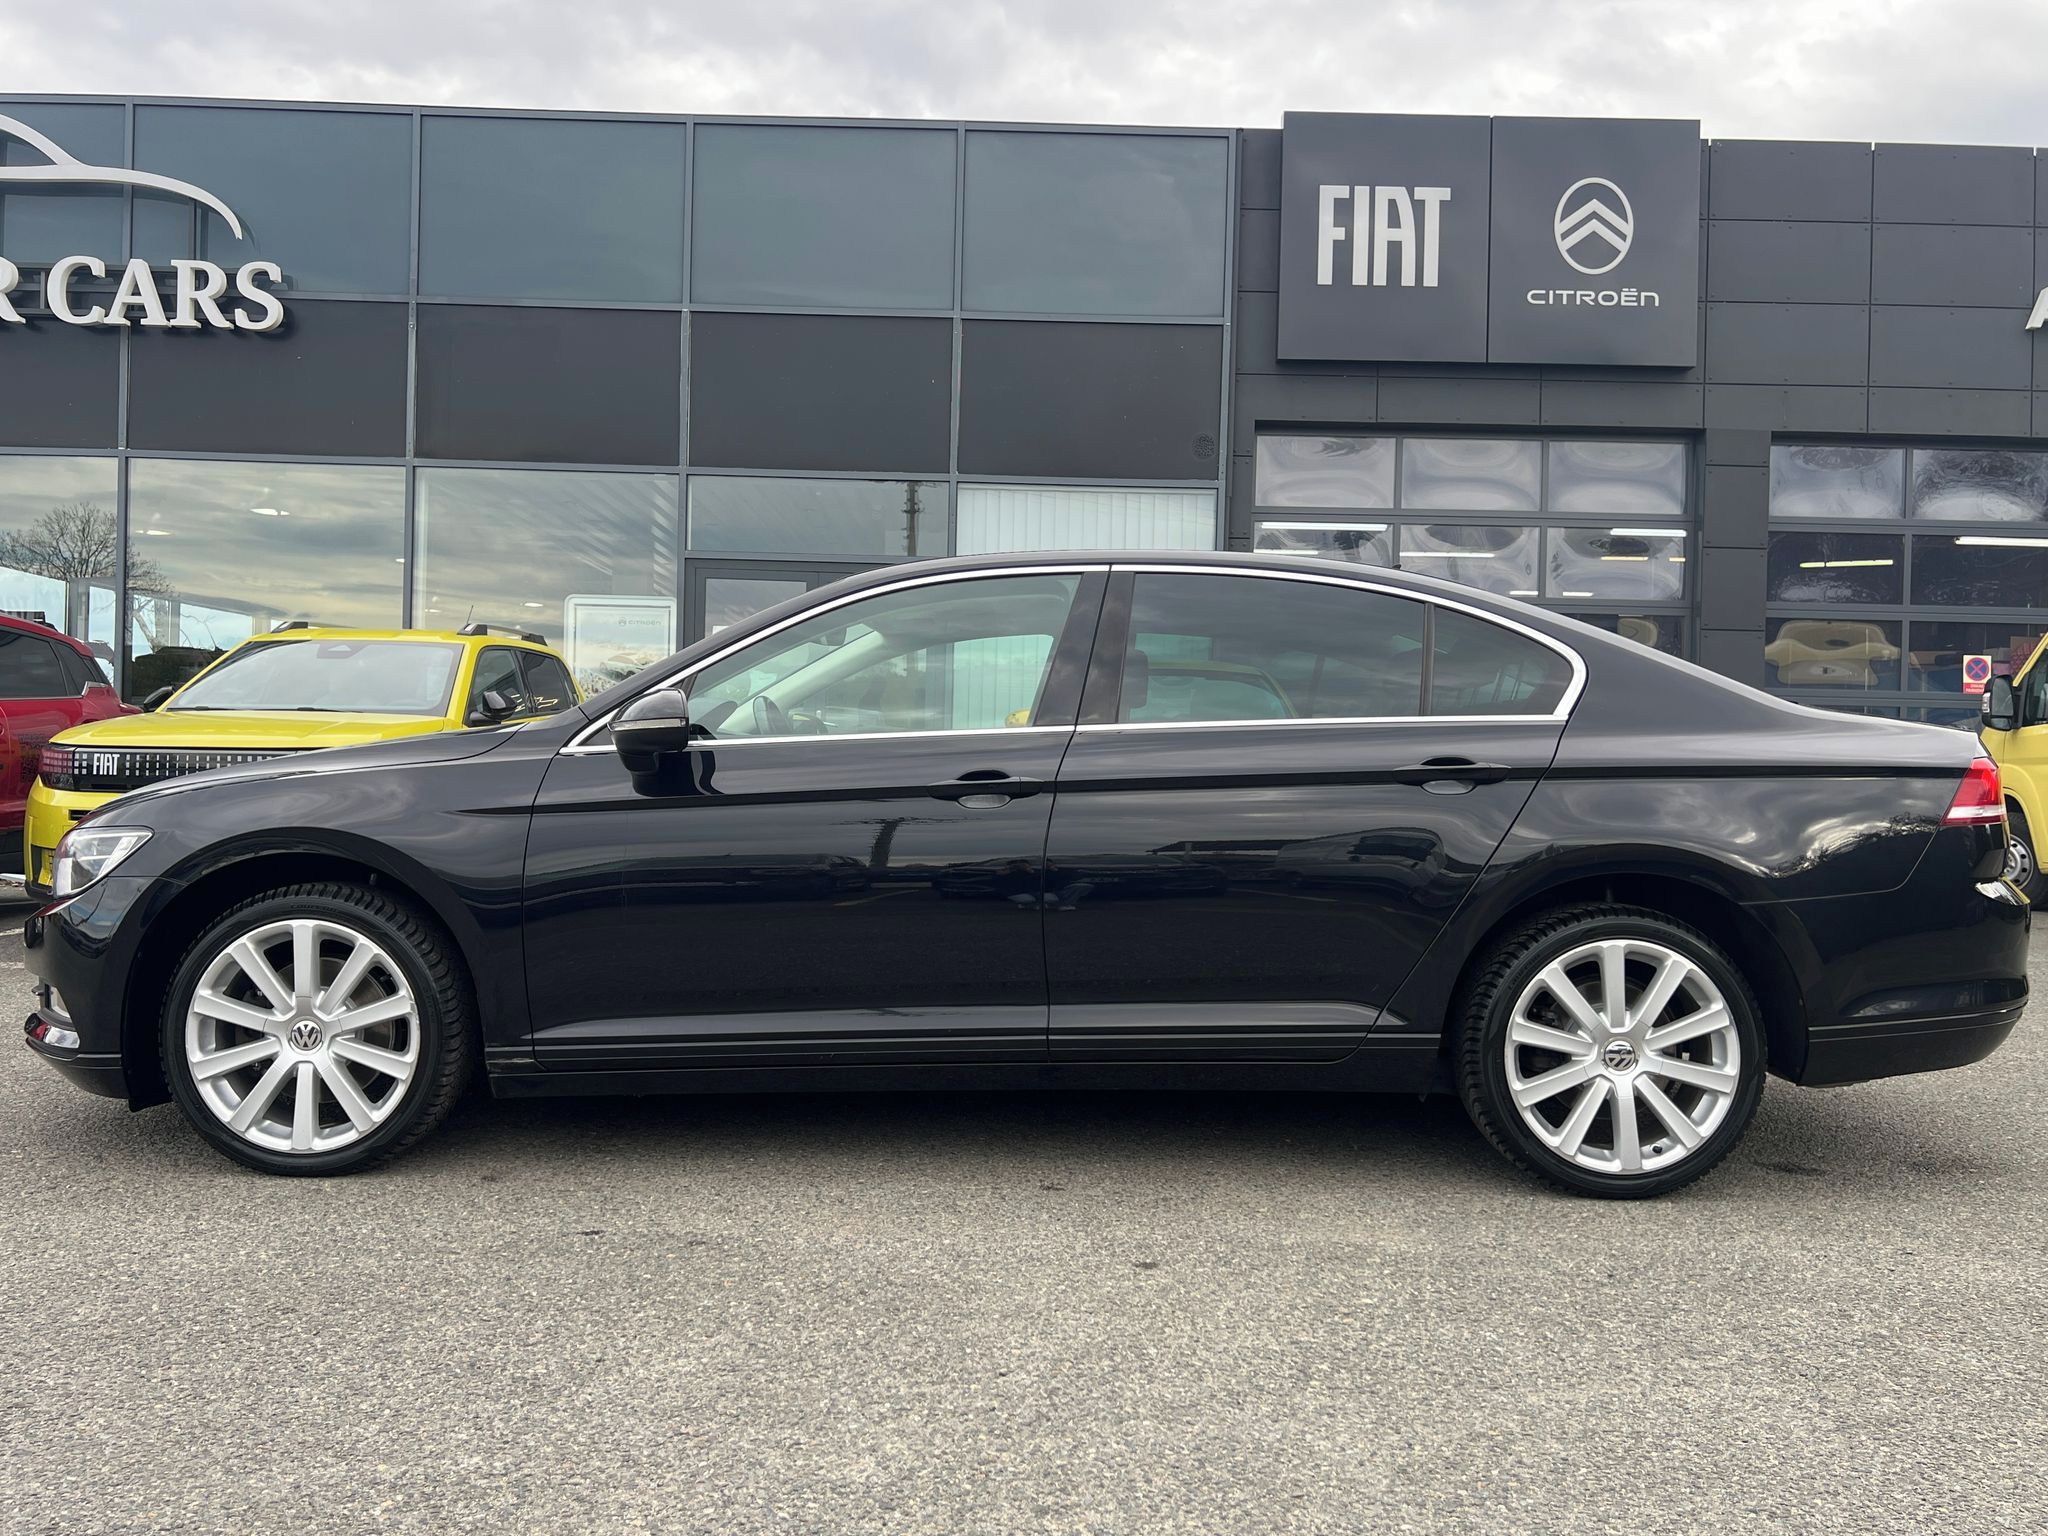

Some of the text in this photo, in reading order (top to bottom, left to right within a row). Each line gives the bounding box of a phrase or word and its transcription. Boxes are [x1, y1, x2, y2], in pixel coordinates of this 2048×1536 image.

[1317, 185, 1451, 287] FIAT
[47, 255, 284, 332] CARS
[93, 753, 120, 775] FIAT
